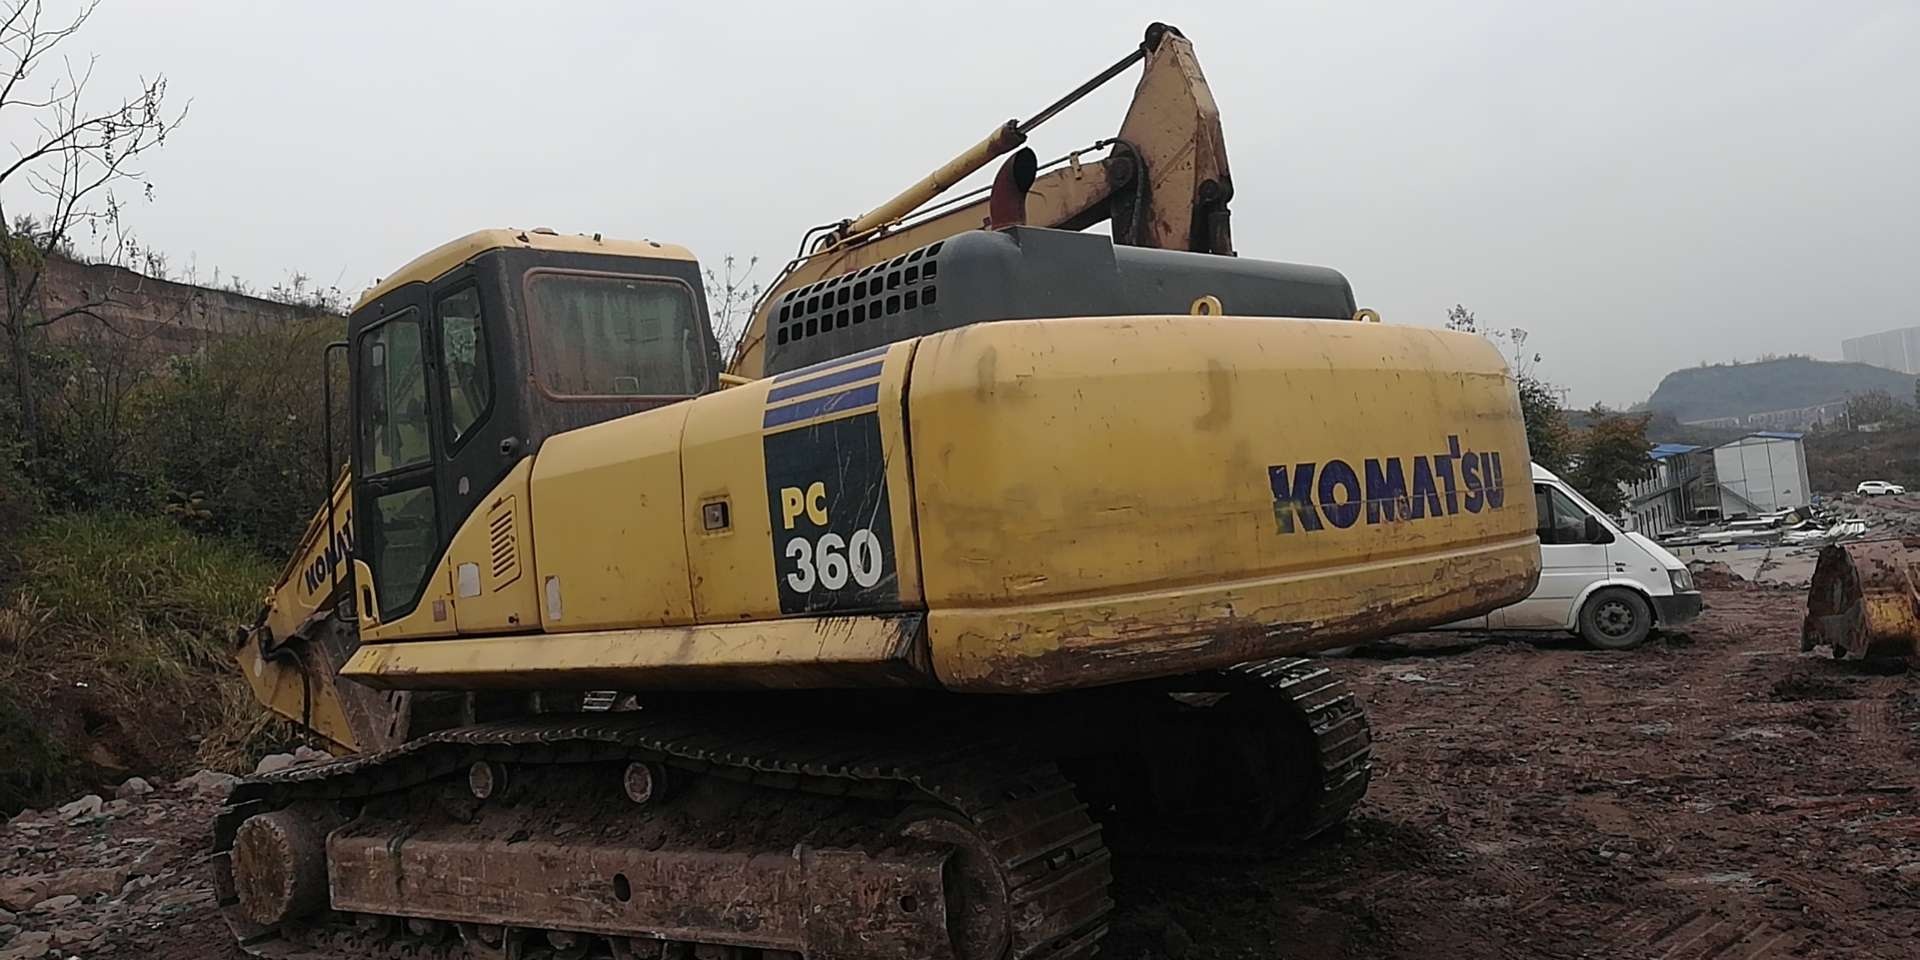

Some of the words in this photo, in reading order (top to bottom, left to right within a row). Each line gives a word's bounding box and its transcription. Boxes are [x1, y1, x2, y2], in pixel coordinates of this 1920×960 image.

[781, 481, 828, 529] PC
[1268, 435, 1504, 534] KOMATSU
[786, 528, 882, 593] 360
